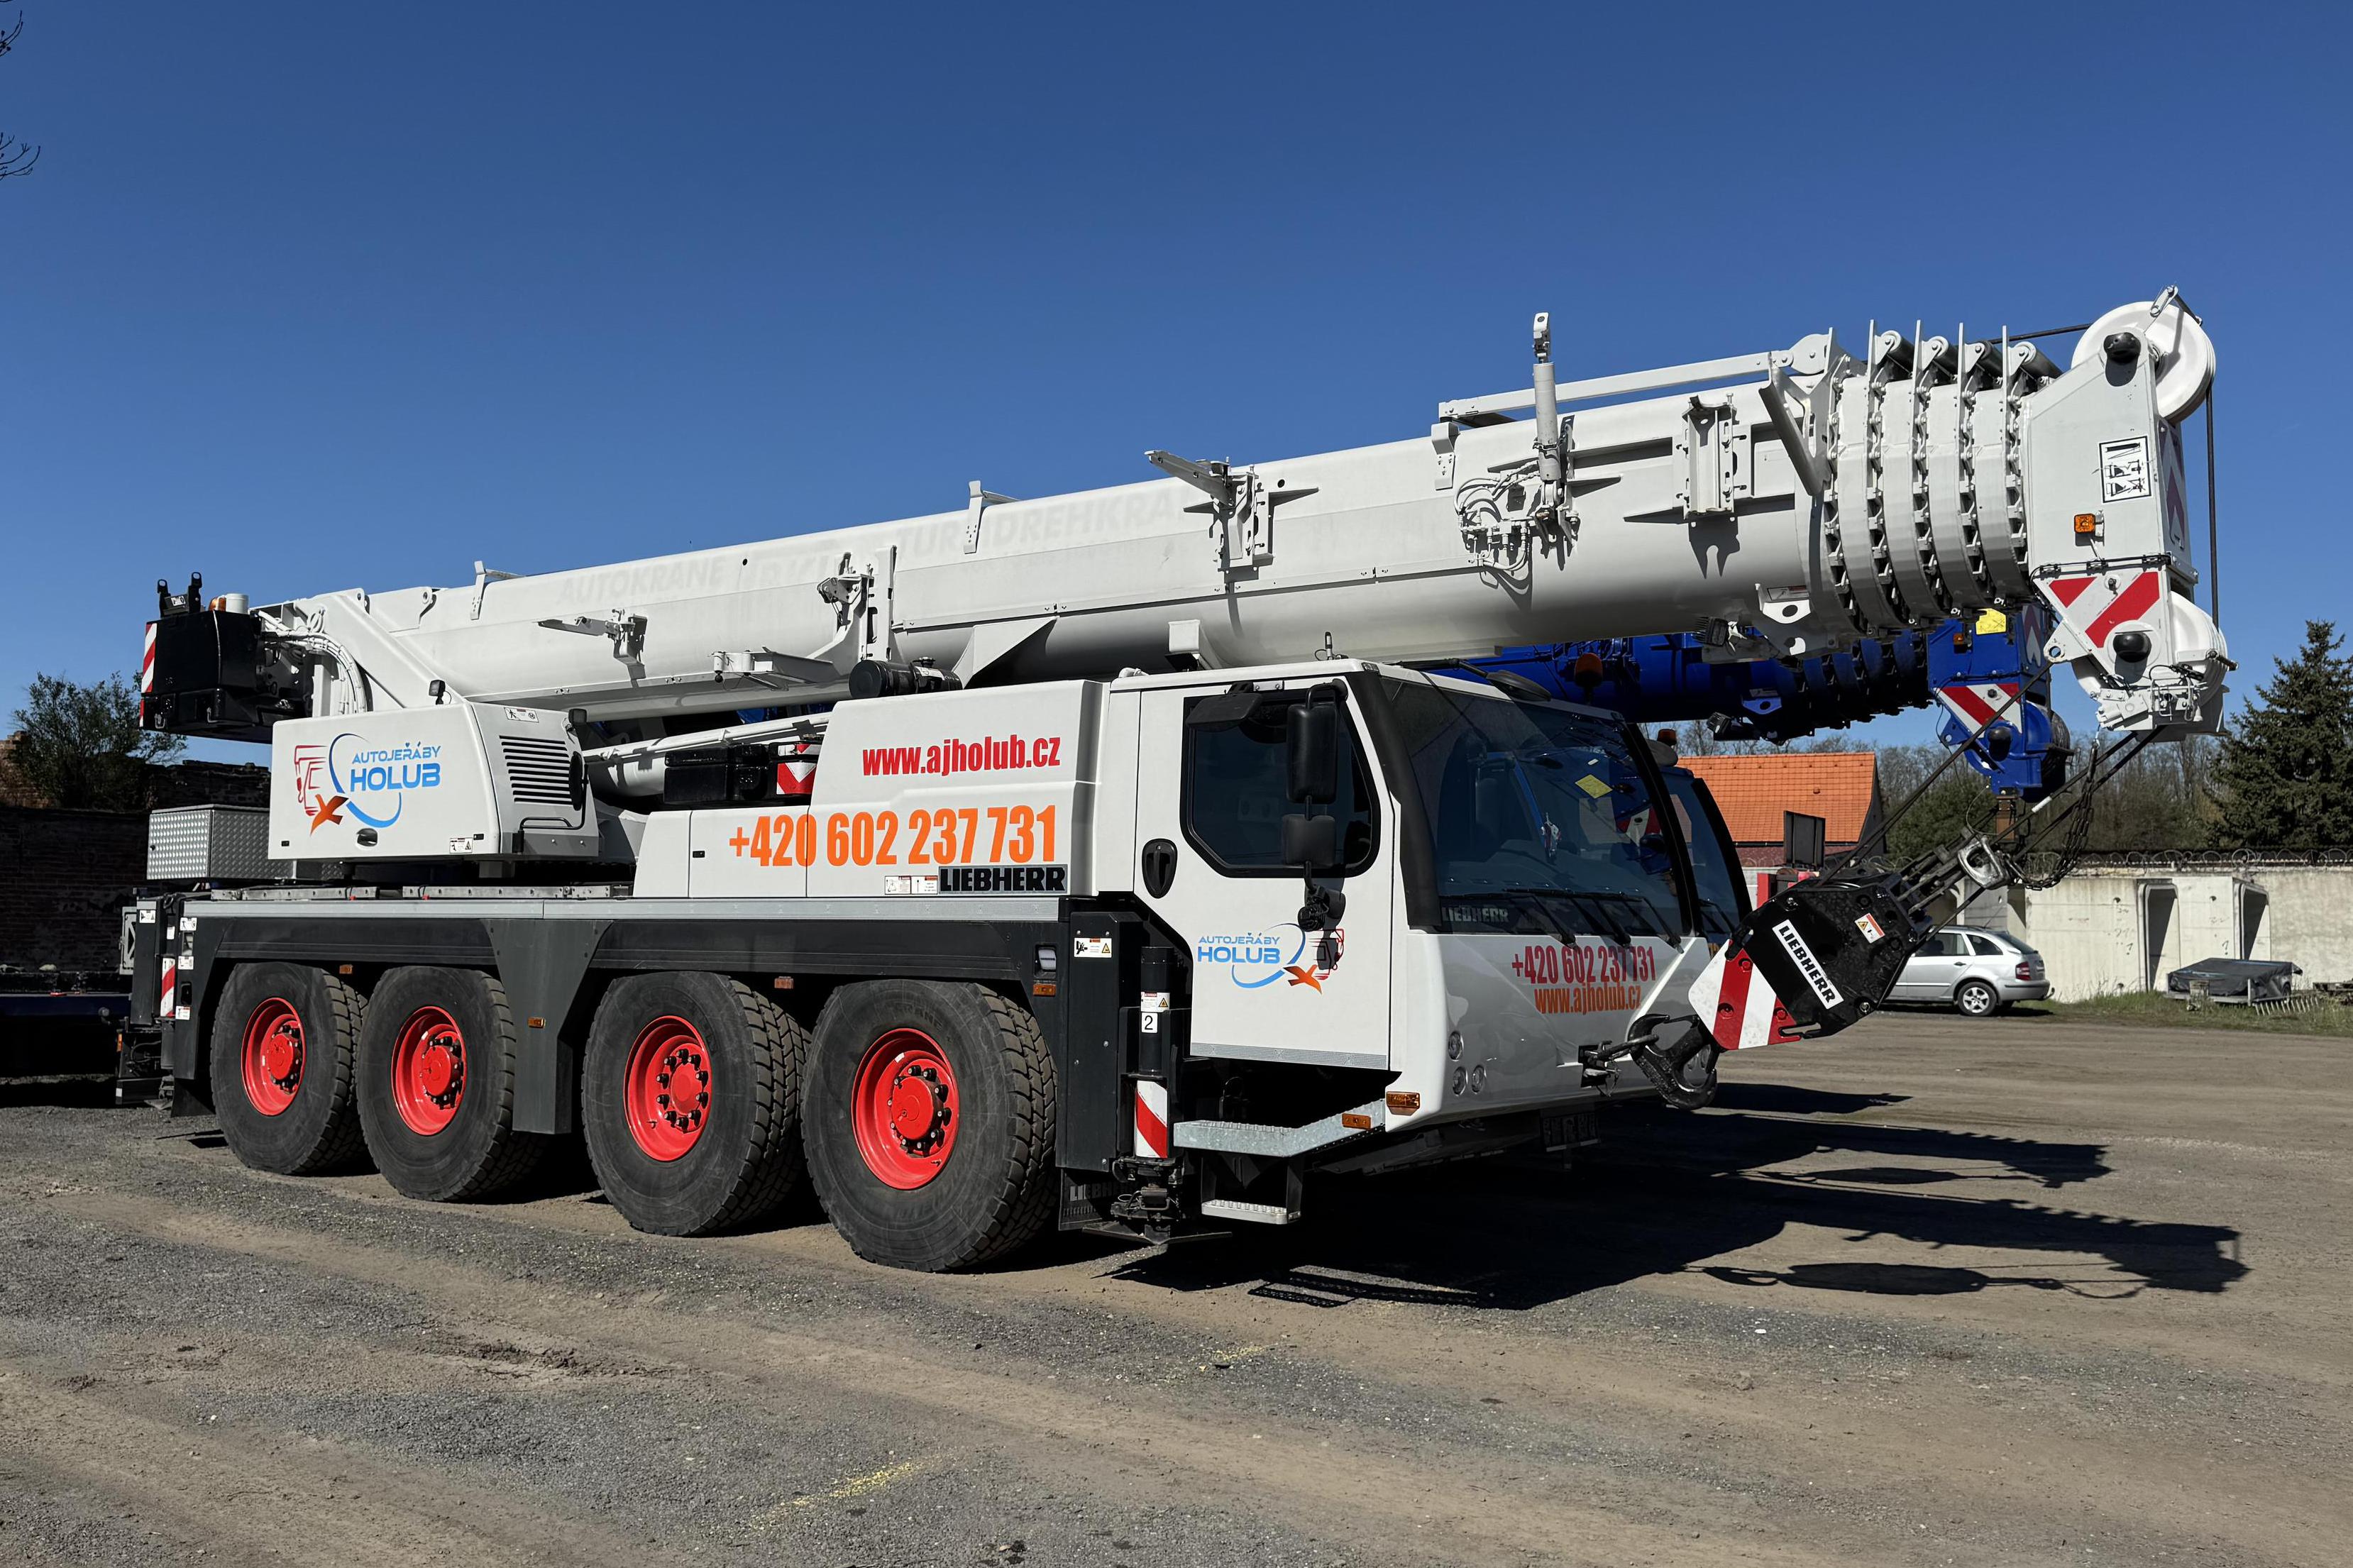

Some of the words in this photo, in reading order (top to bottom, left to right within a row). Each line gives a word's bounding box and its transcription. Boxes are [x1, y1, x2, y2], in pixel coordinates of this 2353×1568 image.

[352, 741, 441, 764] AUTOJEŘÁBY
[862, 734, 1061, 776] www.ajholub.cz
[350, 763, 441, 792] HOLUB
[729, 814, 817, 867] +420
[827, 810, 899, 866] 602
[908, 807, 979, 865] 237
[987, 805, 1056, 863] 731
[940, 867, 1065, 891] LIEBHERR
[1198, 932, 1281, 945] AUTOJEŘÁBY
[1197, 946, 1281, 964] HOLUB
[1511, 945, 1560, 985] +420
[1561, 944, 1597, 984] 602
[1597, 945, 1628, 983] 237
[1628, 945, 1656, 982] 731
[1778, 924, 1836, 1003] LIEBHERR
[1533, 981, 1641, 1015] www.ajholub.cz
[1145, 1015, 1154, 1030] 2
